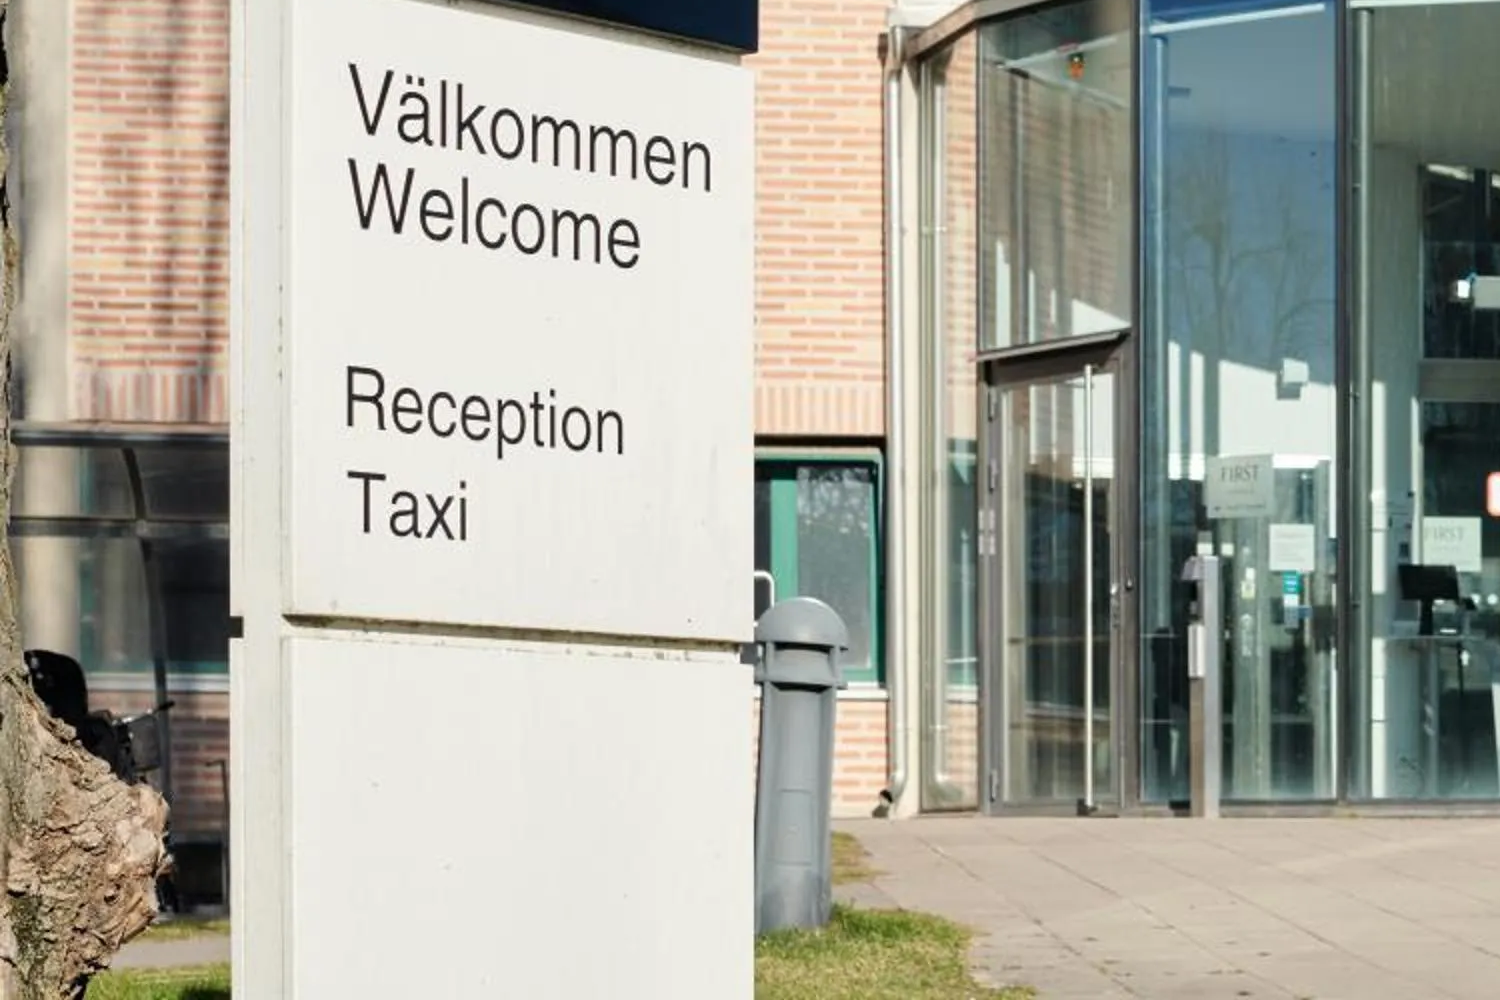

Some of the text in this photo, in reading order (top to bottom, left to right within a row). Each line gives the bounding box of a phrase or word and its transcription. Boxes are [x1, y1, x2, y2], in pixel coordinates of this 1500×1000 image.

[348, 63, 712, 192] Välkommen
[347, 158, 641, 269] Welcome
[346, 366, 624, 459] Reception
[347, 470, 468, 541] Taxi
[1220, 464, 1259, 483] FIRST
